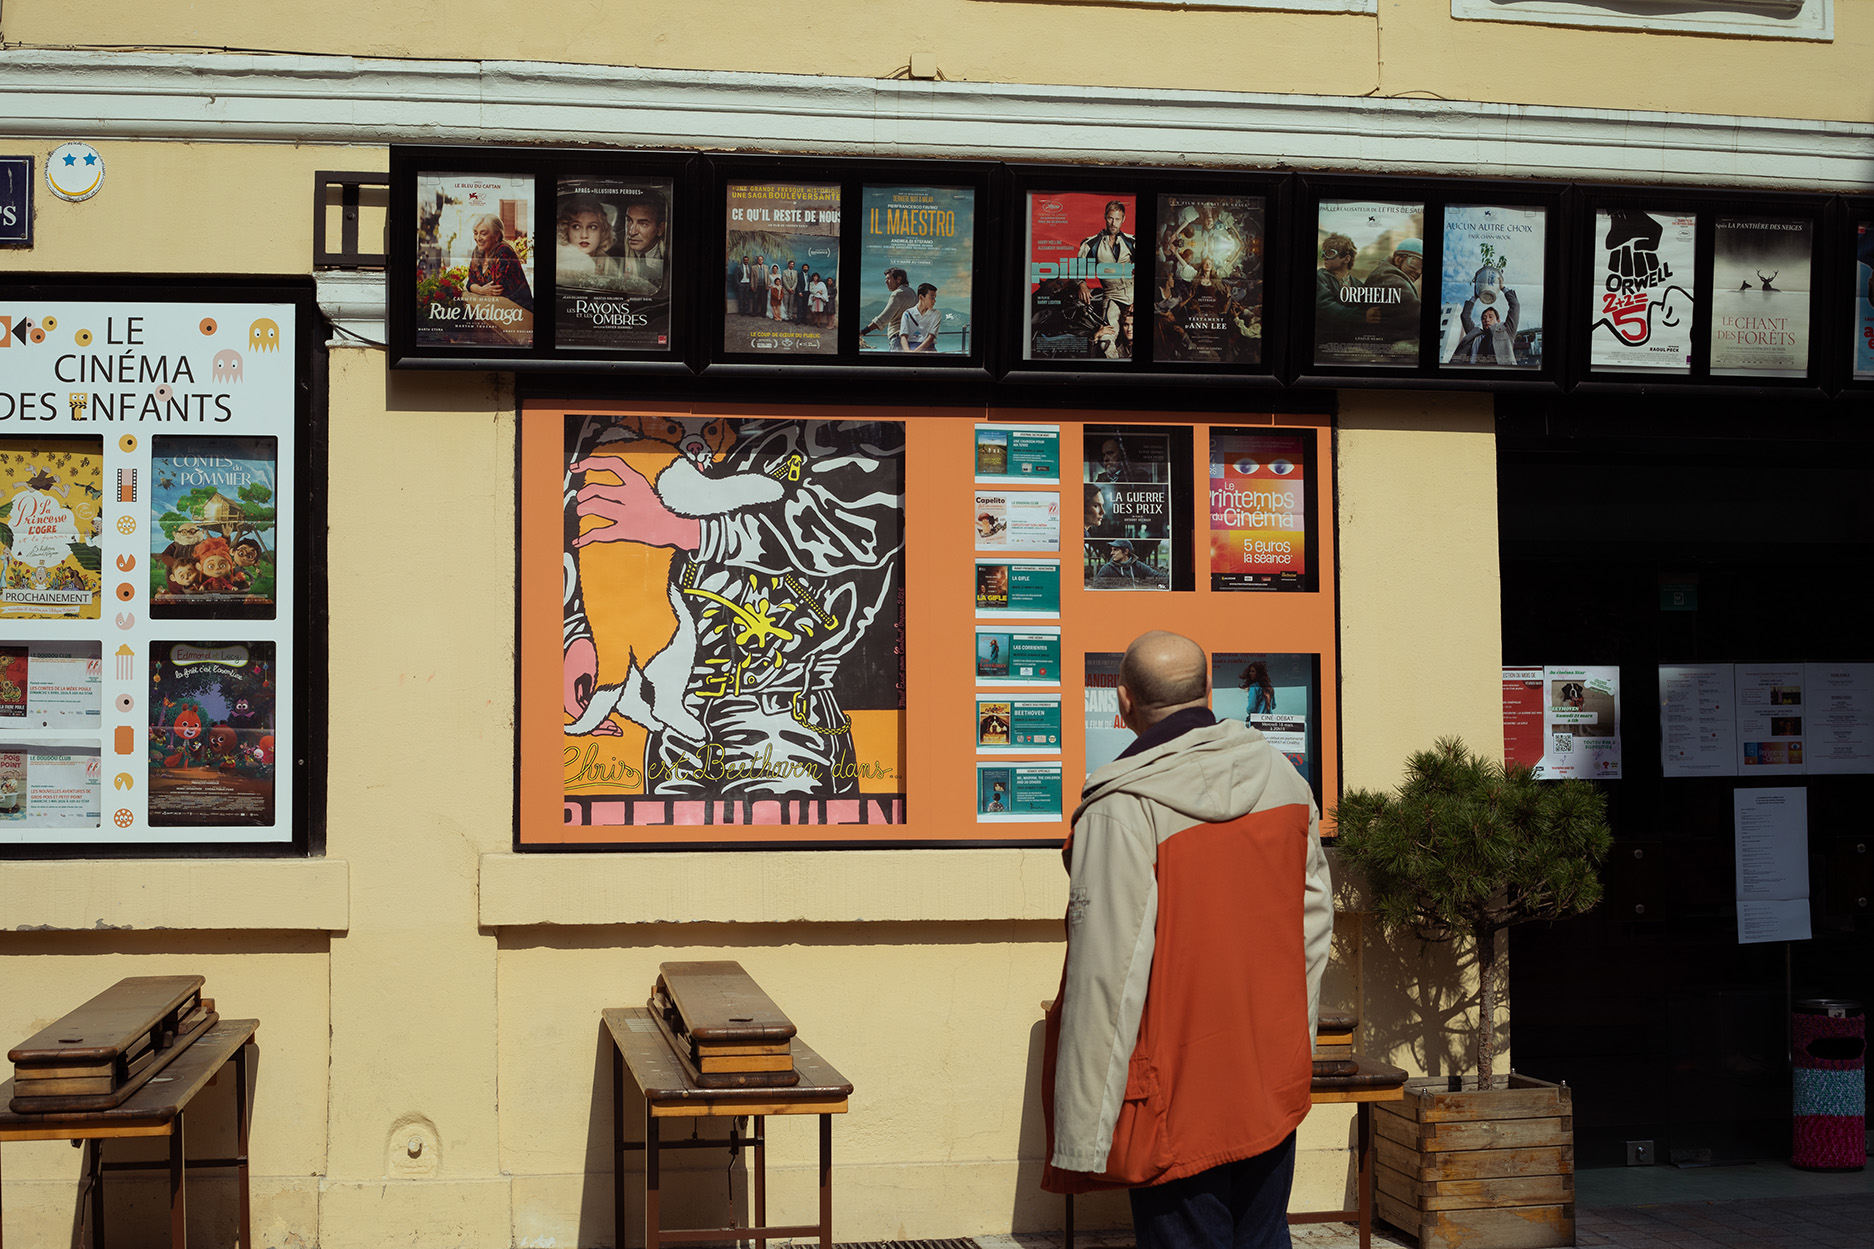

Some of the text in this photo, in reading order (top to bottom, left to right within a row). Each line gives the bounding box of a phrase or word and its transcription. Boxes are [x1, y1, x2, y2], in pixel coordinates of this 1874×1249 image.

[768, 191, 841, 201] BOULEVERSANTE
[732, 208, 744, 221] CE
[747, 208, 770, 222] QU'IL
[773, 209, 802, 222] RESTE
[805, 210, 817, 223] DE
[870, 207, 955, 237] IL MAESTRO
[1446, 222, 1533, 233] AUCUN AUTRE CHOIX
[1737, 222, 1769, 230] PANTHÈRE
[1605, 261, 1673, 296] ORWELL
[1340, 286, 1402, 304] ORPHELIN
[429, 302, 524, 325] Rue Málaga
[576, 299, 631, 315] RAYONS
[592, 313, 649, 327] OMBRES
[1722, 316, 1789, 331] LE CHANT
[107, 317, 144, 345] LE
[1717, 329, 1795, 346] DES FORÊTS
[54, 349, 195, 384] CINÉMA
[0, 392, 57, 421] DES
[173, 454, 233, 468] CONTES
[232, 464, 243, 472] du
[181, 469, 253, 486] POMMIER
[1224, 481, 1235, 491] Le
[975, 497, 1006, 505] Capelito
[1109, 491, 1165, 503] LA GUERRE
[1210, 488, 1295, 512] rintemps
[1113, 503, 1163, 515] DES PRIX
[1211, 504, 1294, 528] du Cinéma
[28, 525, 57, 535] L'OGRE
[1243, 539, 1291, 554] 5 euros
[1243, 552, 1253, 564] la
[5, 592, 90, 603] PROCHAINEMENT
[176, 649, 243, 665] Edmond Lucy
[1085, 673, 1120, 688] ANDRI
[648, 750, 691, 780] est
[691, 742, 824, 782] Beethoven
